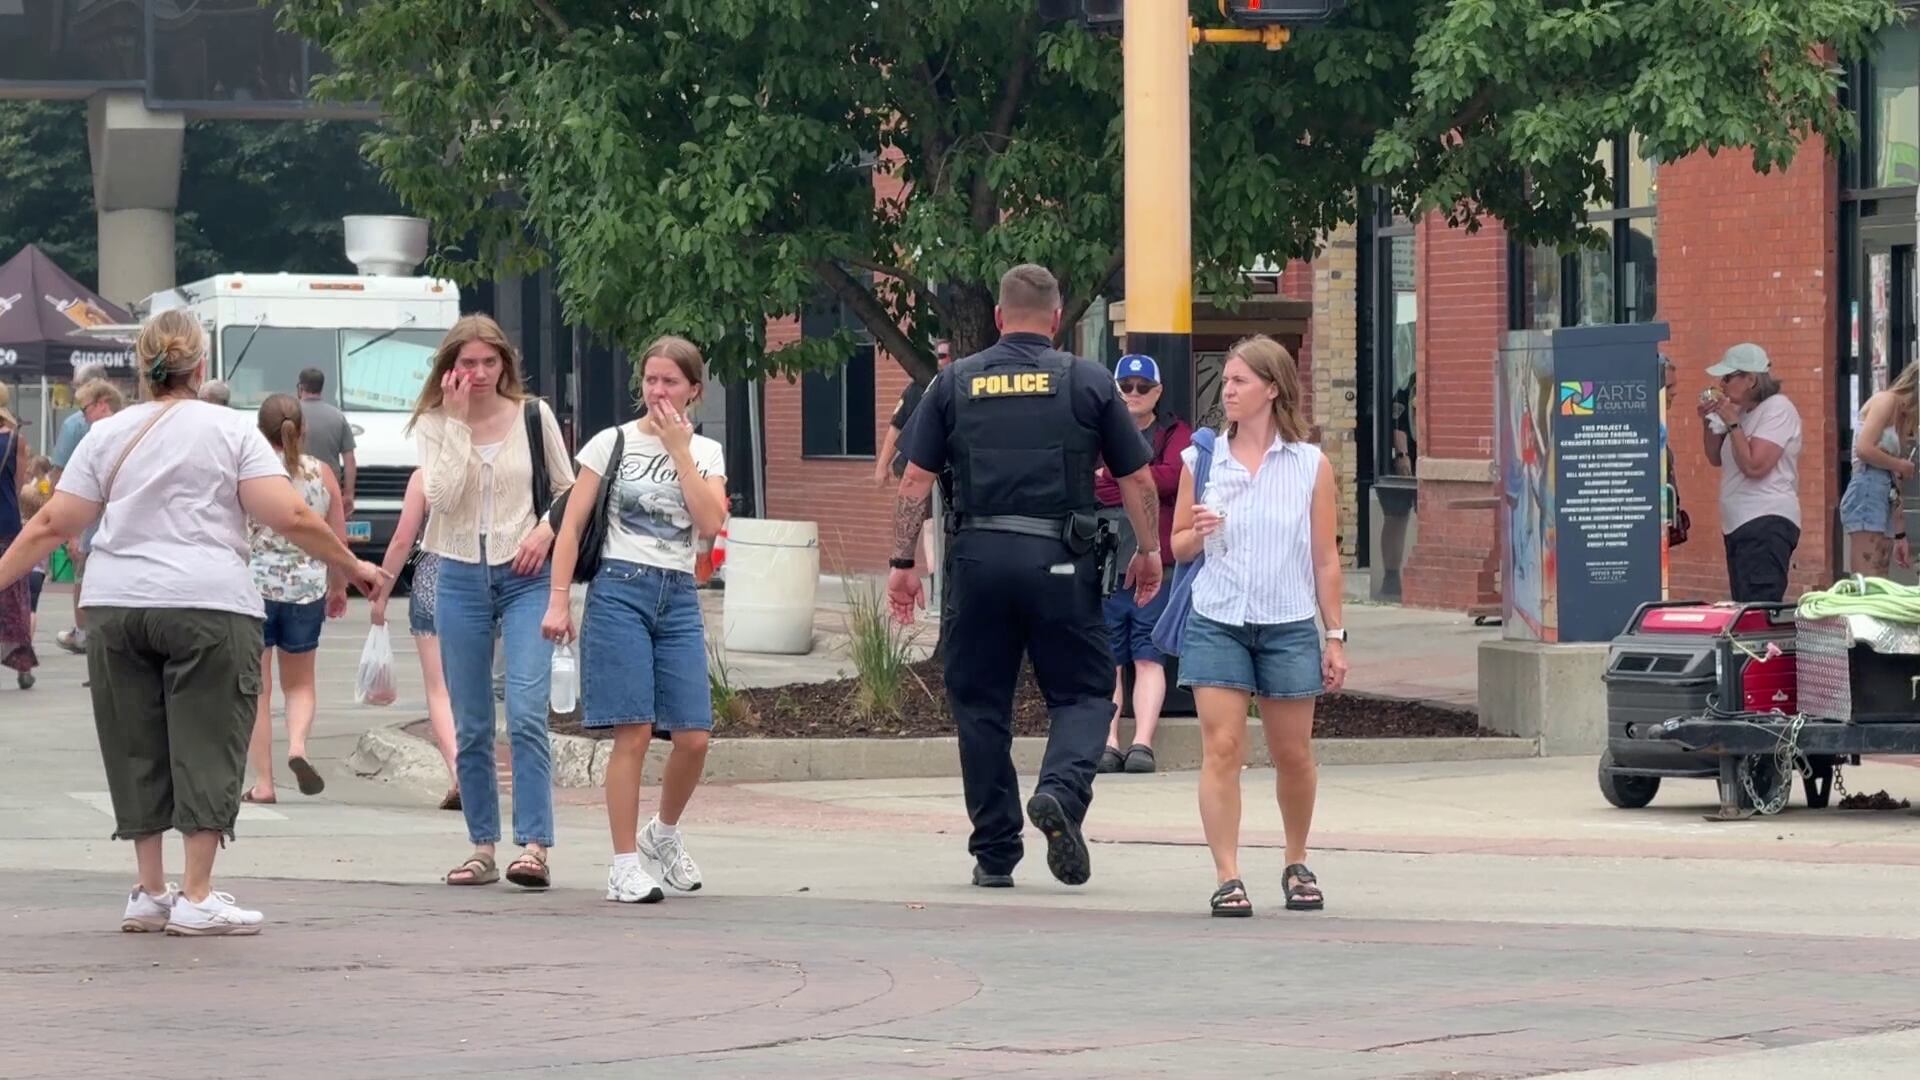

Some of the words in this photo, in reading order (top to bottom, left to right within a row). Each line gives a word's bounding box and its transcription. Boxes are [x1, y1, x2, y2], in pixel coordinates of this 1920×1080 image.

[971, 373, 1050, 396] POLICE
[1596, 384, 1647, 401] ARTS
[1604, 401, 1647, 410] CULTURE
